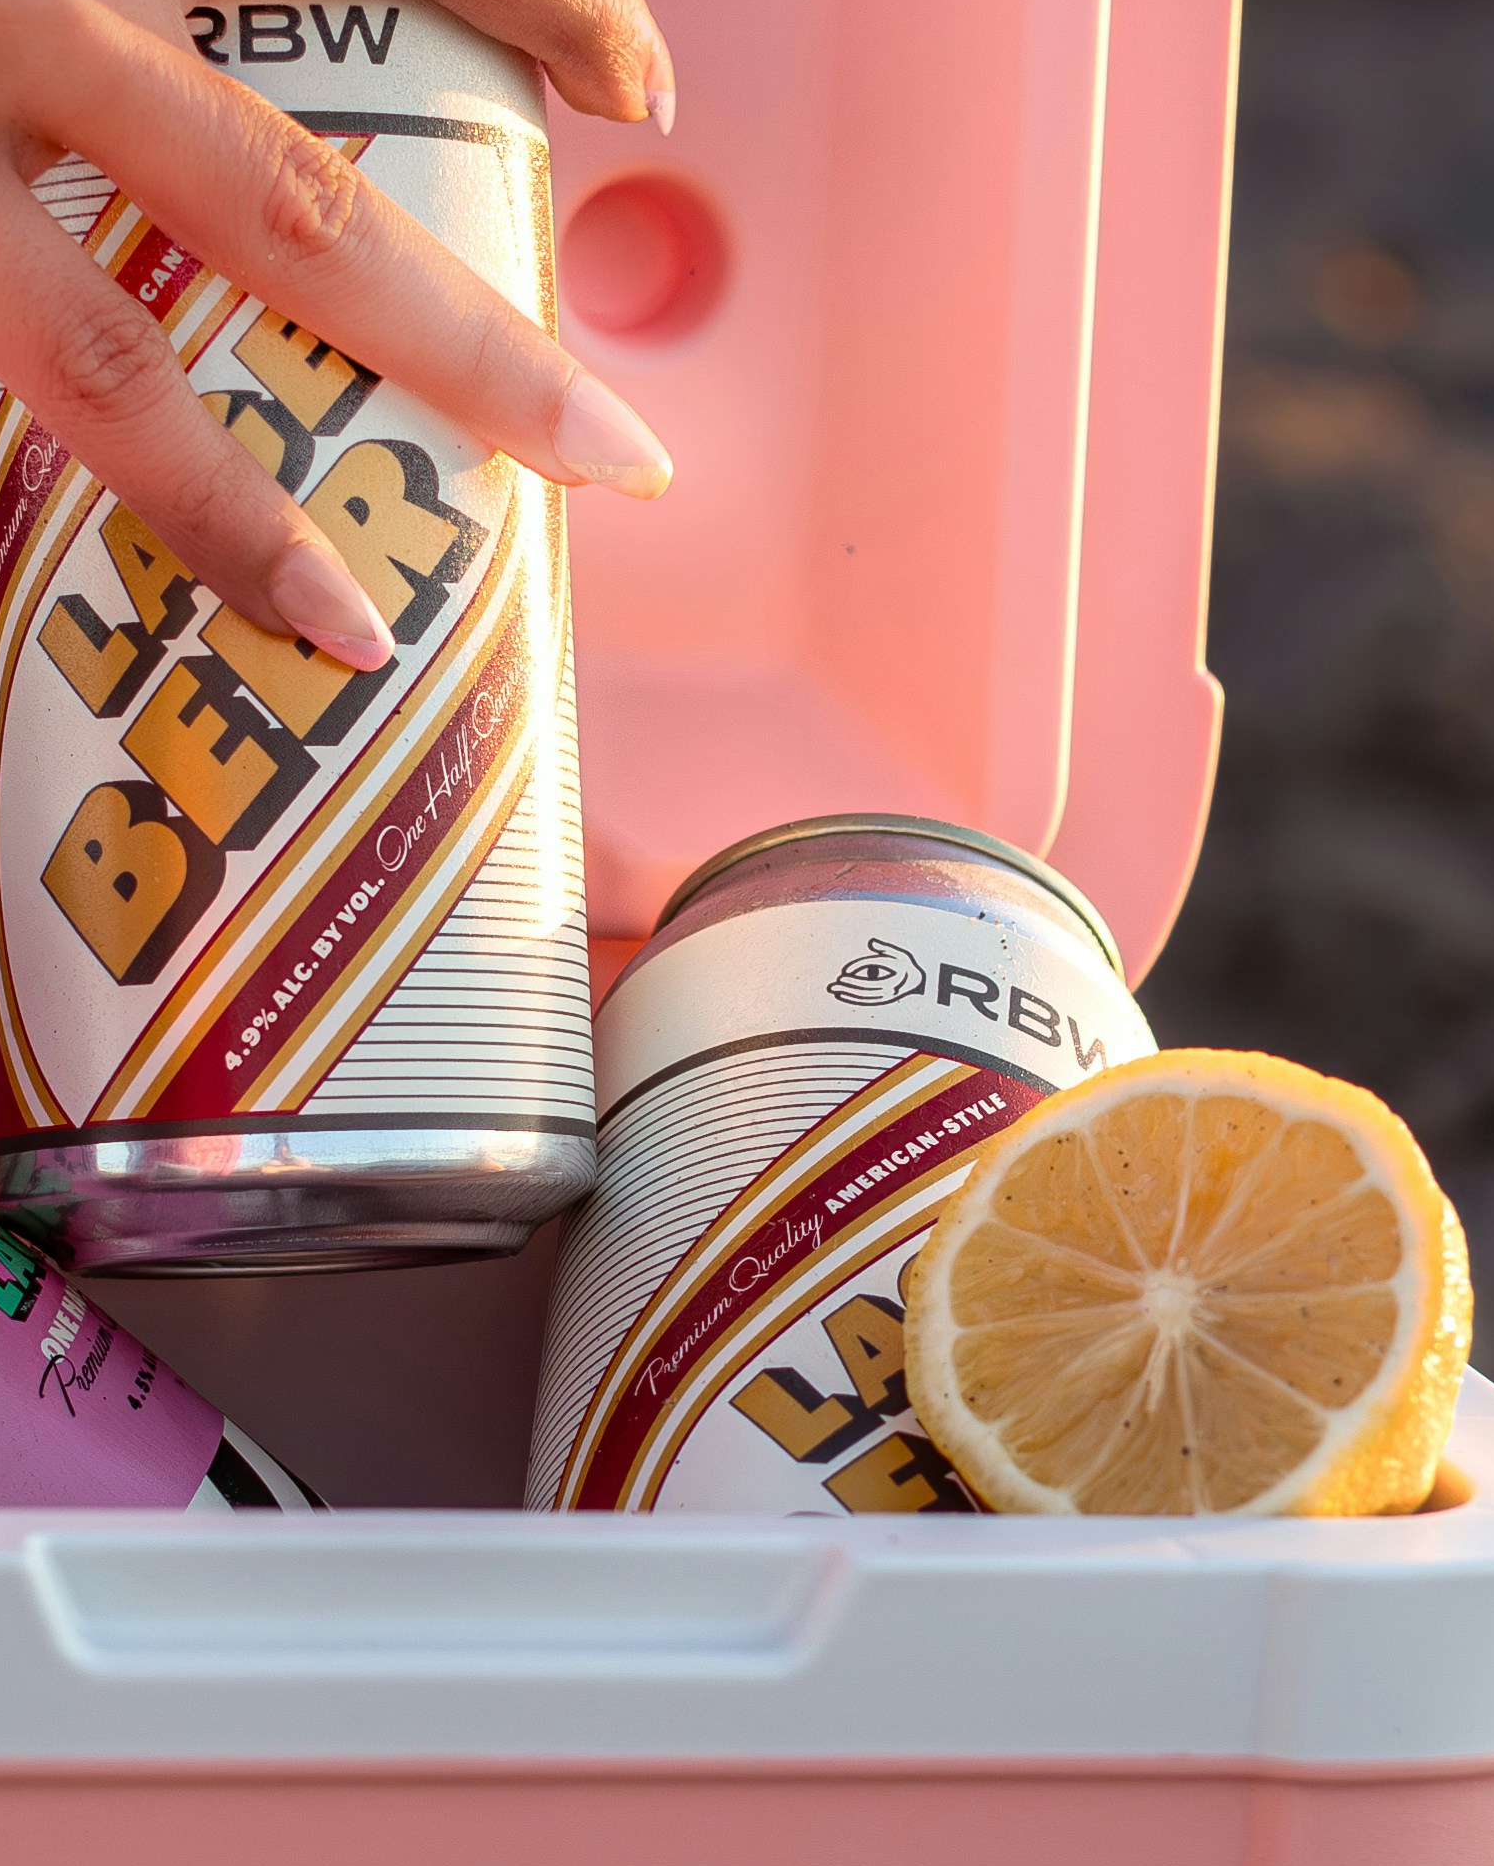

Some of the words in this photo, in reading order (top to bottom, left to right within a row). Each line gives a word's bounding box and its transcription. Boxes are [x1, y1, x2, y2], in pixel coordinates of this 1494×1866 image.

[184, 3, 401, 66] RBW
[225, 1008, 278, 1070] 4.9%
[272, 961, 319, 1011] ALC.
[311, 922, 343, 959] BY
[336, 878, 386, 925] VOL.
[376, 815, 427, 872] One
[635, 1296, 733, 1397] Premium
[727, 1213, 824, 1294] Quality
[824, 1092, 1007, 1214] AMERICAN-STYLE
[38, 1325, 114, 1418] Premium
[40, 1310, 80, 1364] ONE
[728, 1251, 919, 1463] LA
